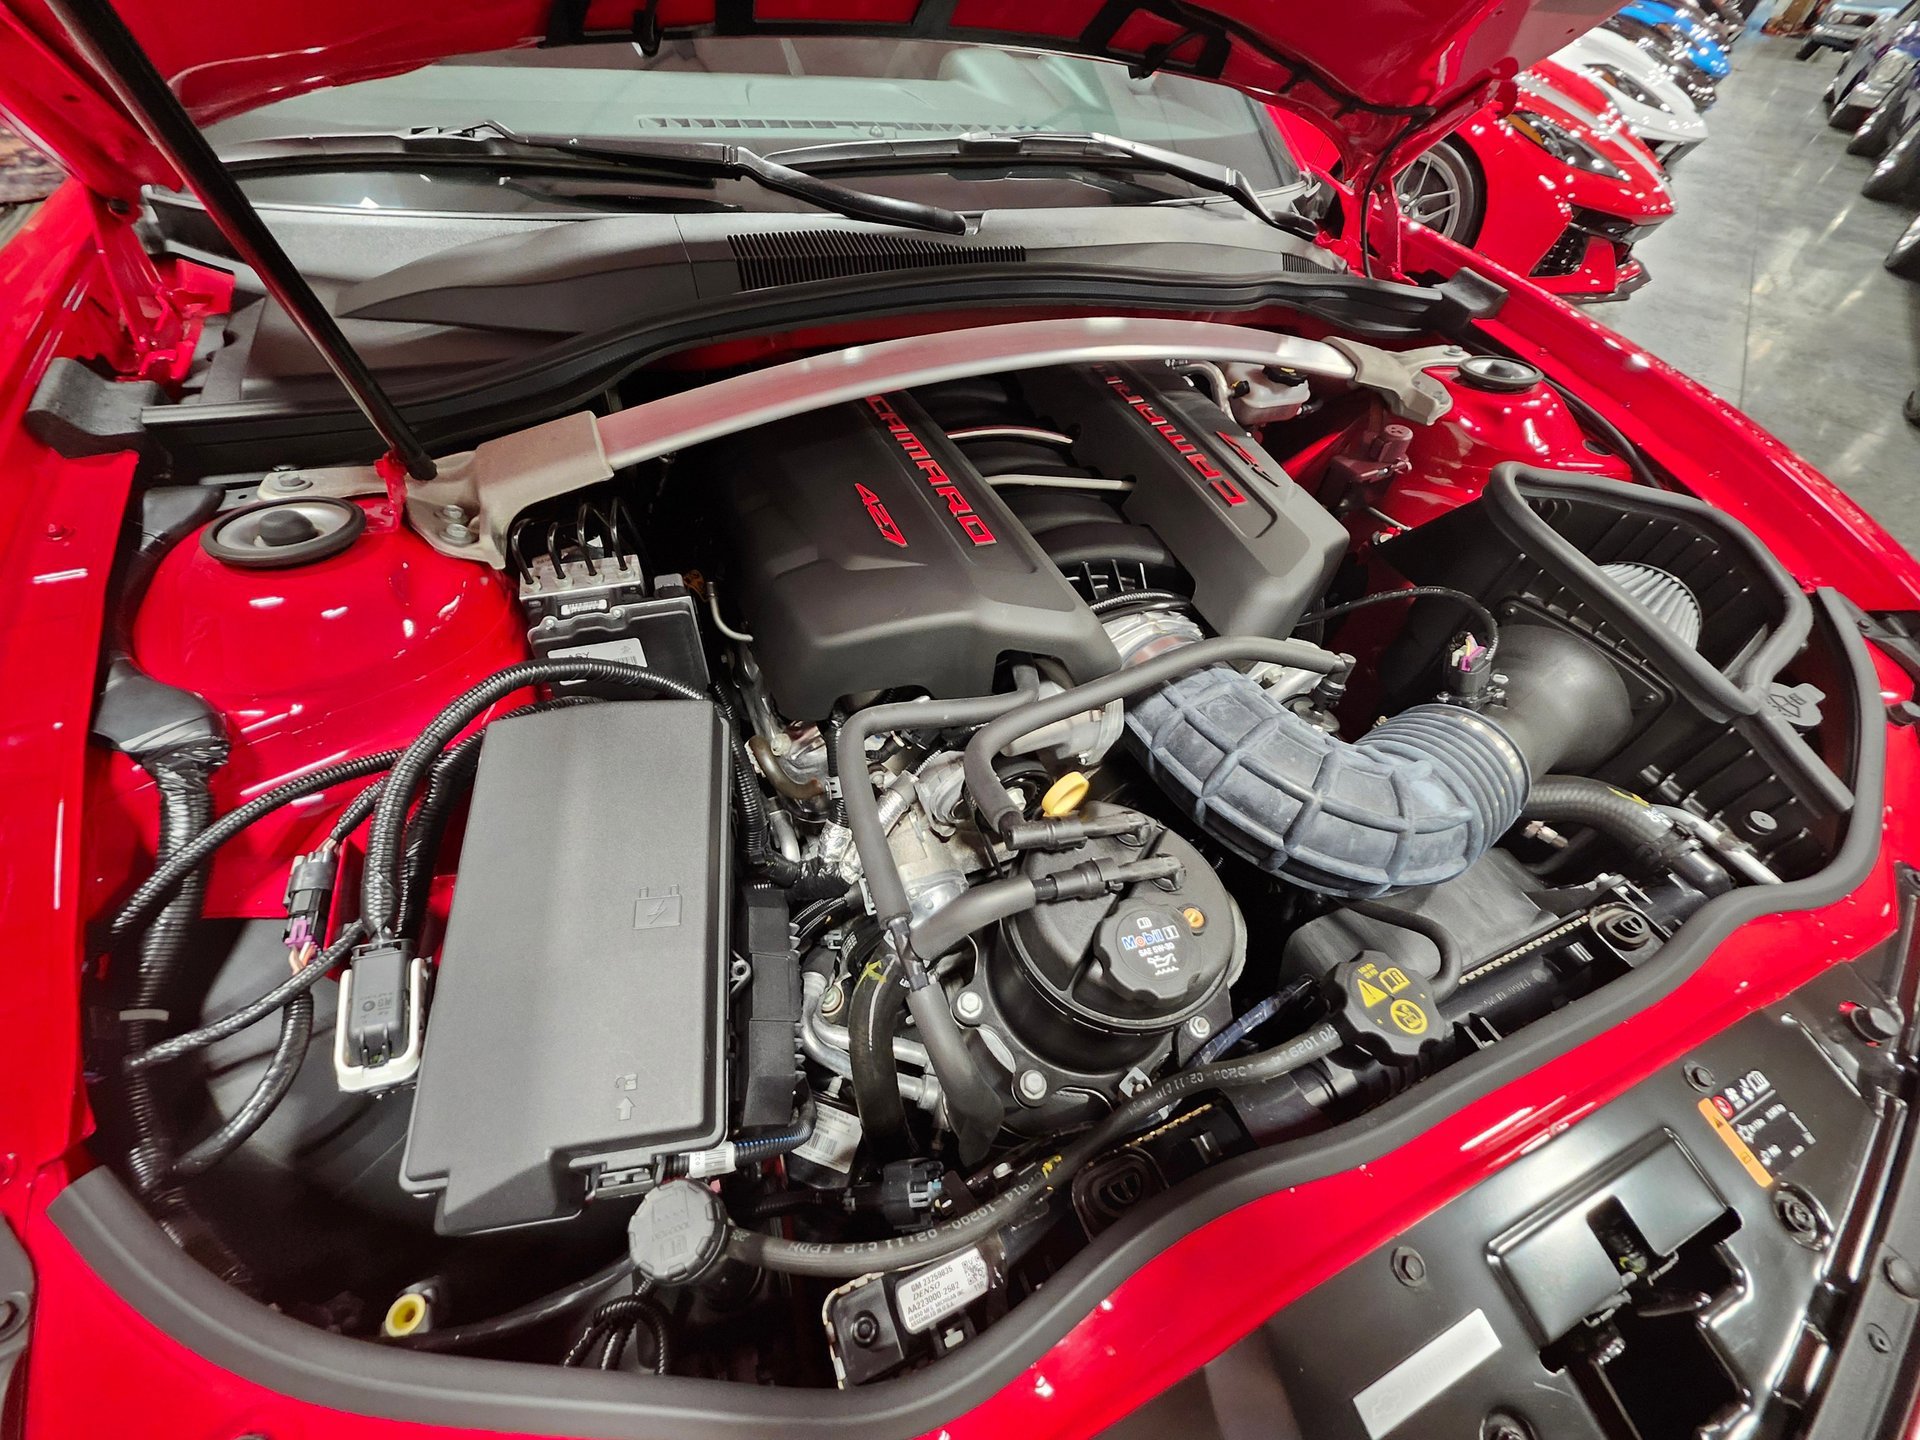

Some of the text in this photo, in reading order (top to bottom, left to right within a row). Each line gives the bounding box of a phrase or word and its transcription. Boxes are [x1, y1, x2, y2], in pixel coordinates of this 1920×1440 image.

[866, 395, 997, 547] CAMARO
[855, 482, 909, 548] 427
[1121, 928, 1164, 951] Mobil
[1138, 947, 1153, 957] SAE
[913, 1281, 941, 1300] DENSO
